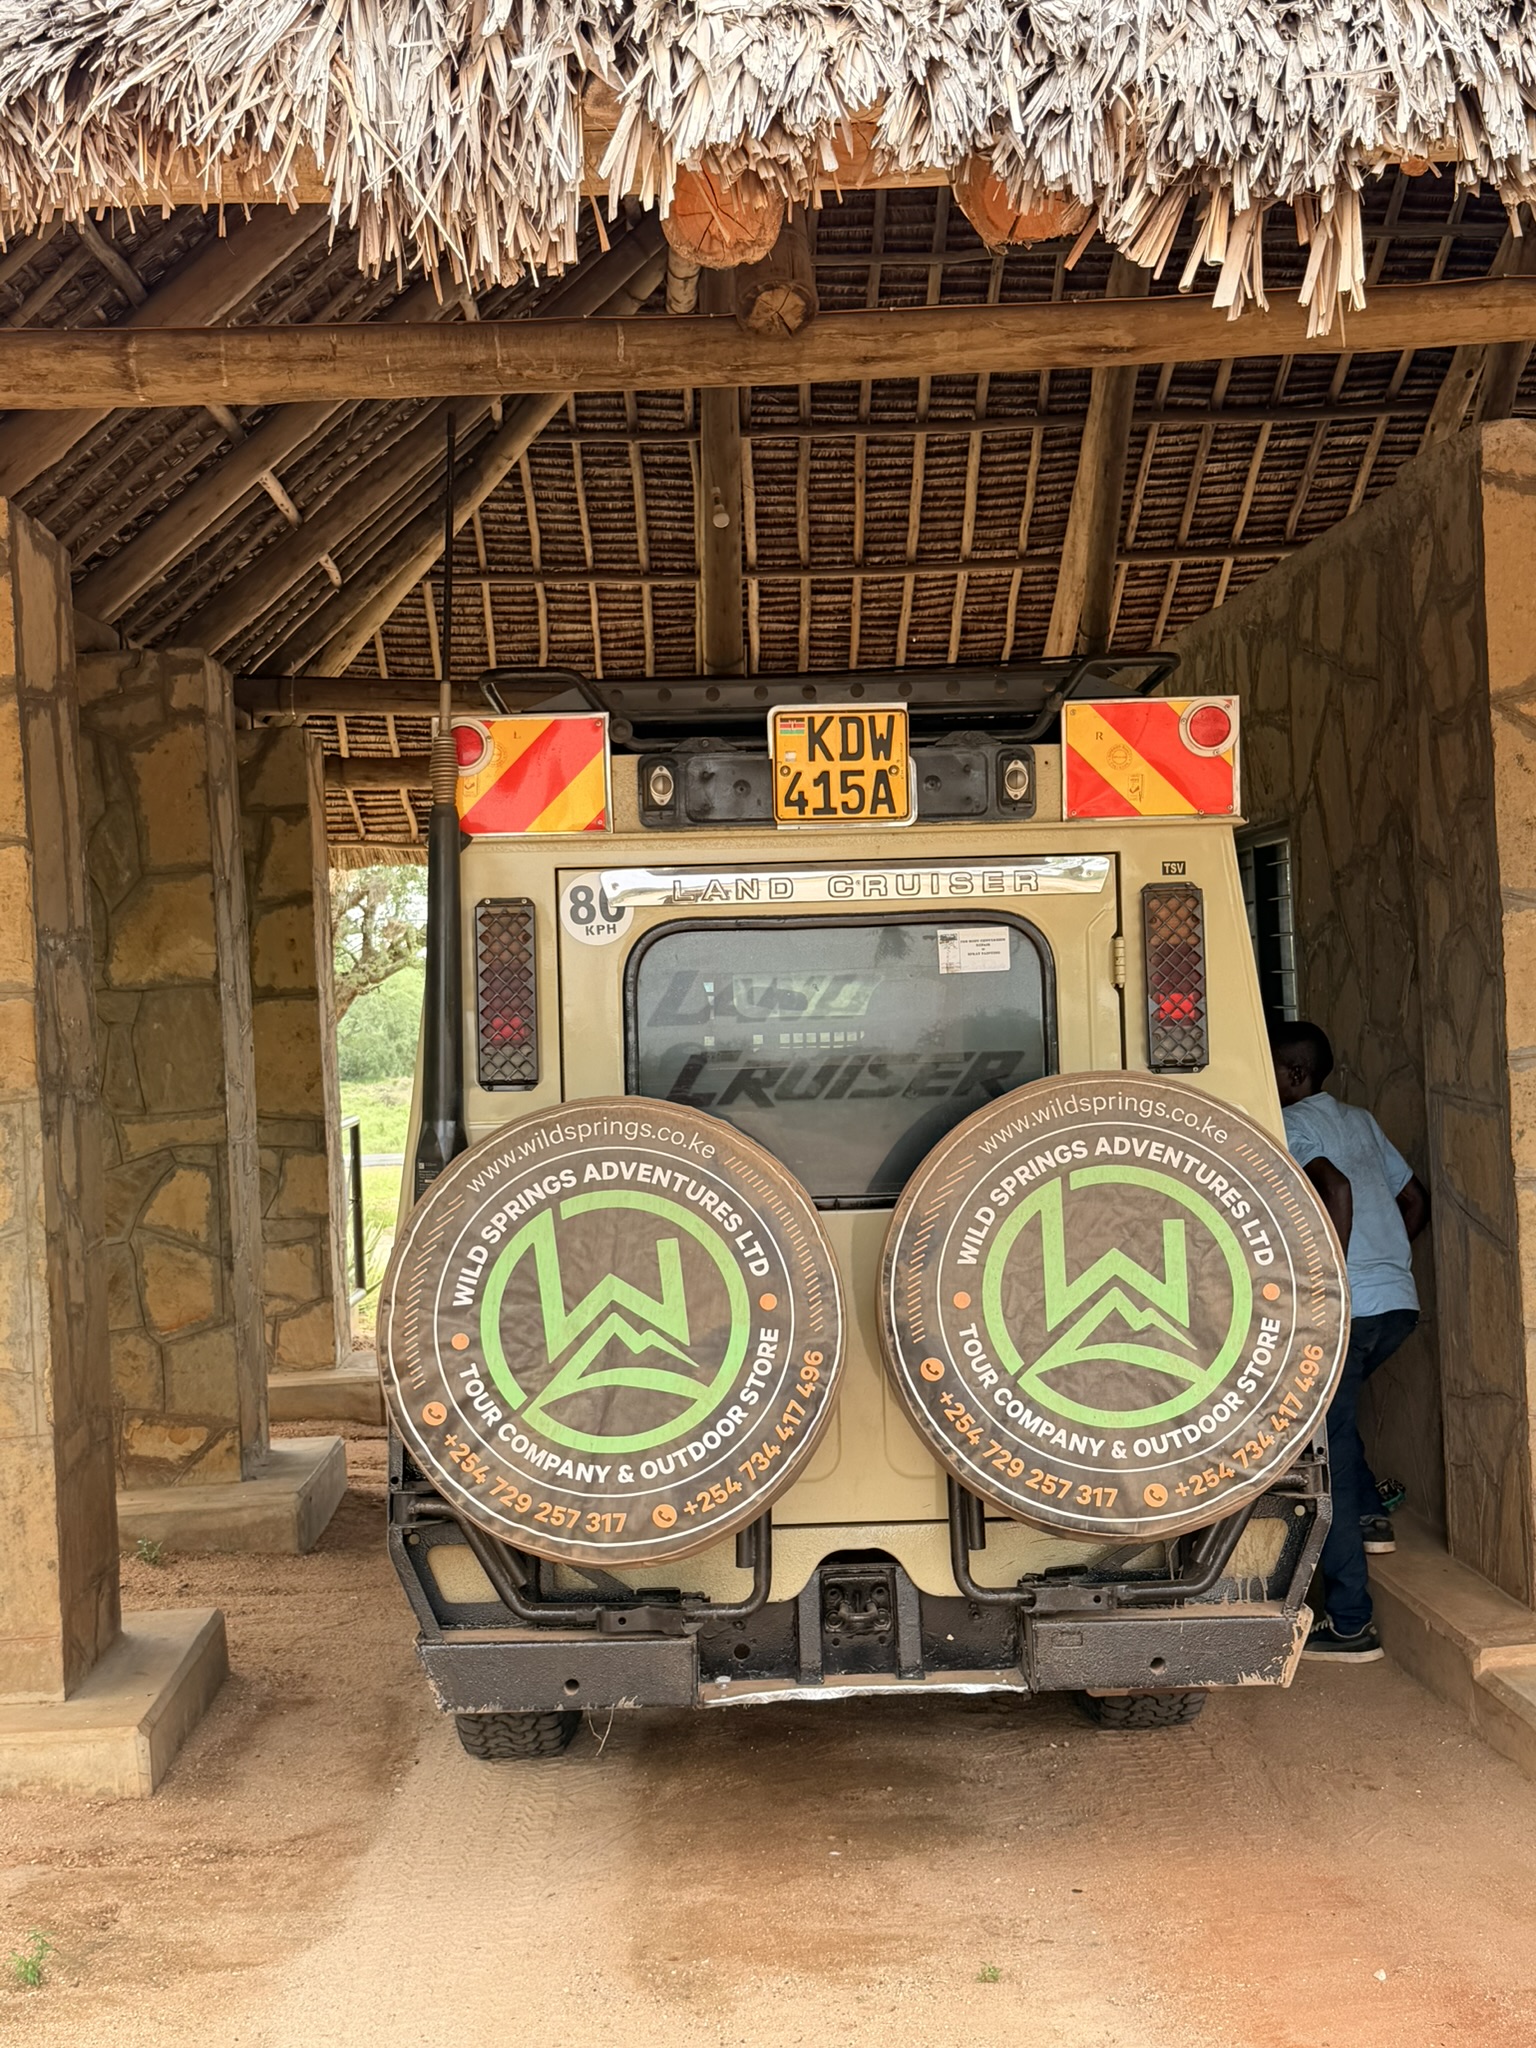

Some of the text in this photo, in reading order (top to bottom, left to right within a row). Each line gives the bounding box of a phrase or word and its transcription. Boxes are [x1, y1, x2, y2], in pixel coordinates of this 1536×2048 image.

[808, 714, 895, 762] KDW
[1095, 731, 1104, 741] R
[784, 769, 897, 815] 415A
[673, 870, 1039, 901] LAND CRUISER
[1163, 862, 1184, 874] TSV
[585, 923, 617, 936] KPH
[666, 1050, 1025, 1108] CRUISER
[466, 1117, 716, 1193] www.wildsprings.co.ke
[978, 1092, 1229, 1156] www.wildsprings.co.ke
[452, 1245, 489, 1307] WILD
[483, 1168, 577, 1244] SPRINGS
[583, 1161, 743, 1233] ADVENTURES
[735, 1230, 771, 1278] LTD
[956, 1136, 1274, 1267] WILD SPRINGS ADVENTURES LTD
[459, 1327, 779, 1484] TOUR COMPANY & OUTDOOR STORE
[958, 1317, 1281, 1459] TOUR COMPANY & OUTDOOR STORE
[1174, 1344, 1324, 1500] +254 734 417 496
[683, 1349, 824, 1517] +254 734 417 496
[939, 1390, 1119, 1508] +254 729 257 317
[444, 1433, 627, 1533] +254 729 257 317
